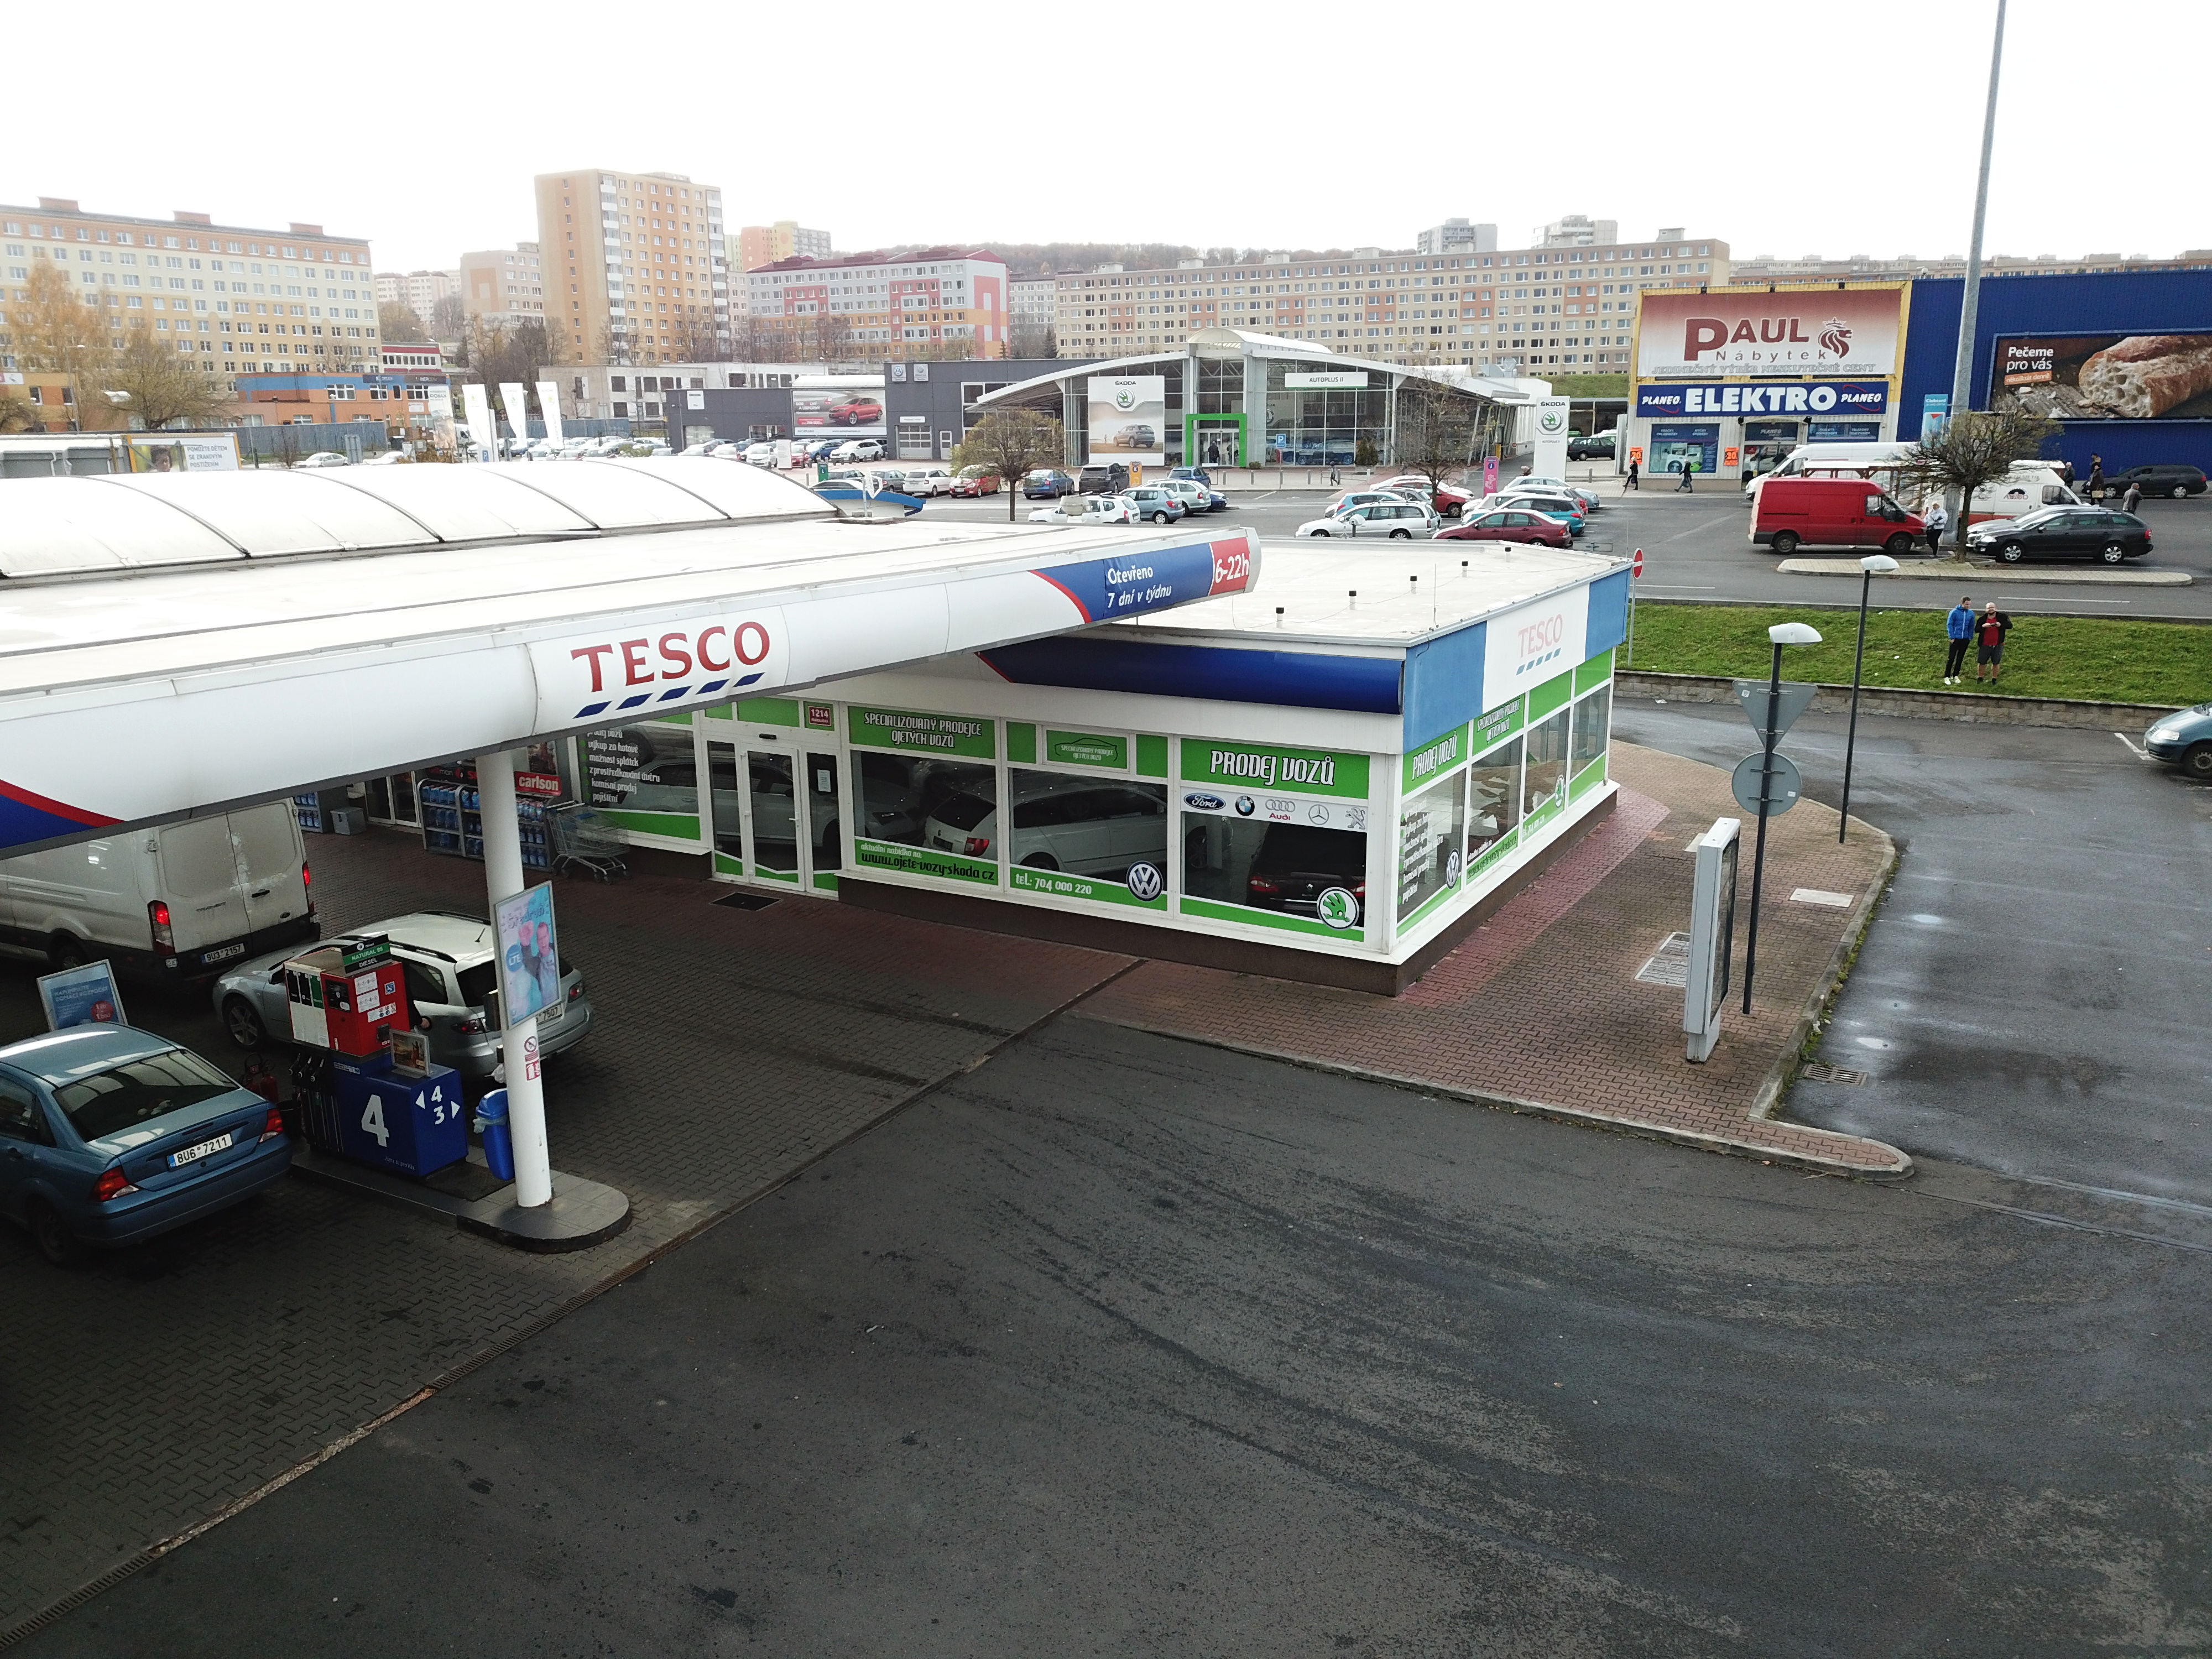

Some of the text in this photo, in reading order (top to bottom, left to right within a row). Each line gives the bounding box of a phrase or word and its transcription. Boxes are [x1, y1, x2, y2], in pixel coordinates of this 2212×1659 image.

[1684, 317, 1809, 361] PAUL
[1716, 350, 1827, 363] Nábytek
[2008, 346, 2054, 357] Pečeme
[1652, 364, 1717, 375] JEDINEČNÝ
[1761, 362, 1840, 374] NESKUTEČNÉ
[1843, 363, 1876, 373] CENY
[2006, 357, 2052, 373] pro vás
[1642, 387, 1881, 413] PLANEO ELEKTRO PLANEO
[1108, 565, 1154, 585] Otevřeno
[1215, 553, 1249, 583] 6-22h
[1108, 585, 1172, 608] 7 dní v týdnu
[1518, 614, 1563, 658] TESCO
[571, 621, 770, 692] TESCO
[811, 709, 828, 718] 1214
[864, 712, 982, 737] SPECIALIZOVANÝ PRODEJCE
[588, 740, 607, 752] výkup
[618, 743, 638, 753] hotové
[891, 731, 955, 748] OJETÝCH VOZŮ
[589, 754, 639, 767] možnost splátek
[1412, 730, 1457, 780] PRODEJ VOZŮ
[589, 767, 660, 782] zprostředkování úvěru
[1210, 749, 1335, 786] PRODEJ VOZŮ
[519, 776, 559, 791] carlson
[592, 778, 637, 795] komisní prodej
[593, 792, 618, 803] pojištění
[1192, 795, 1217, 808] Ford
[861, 843, 886, 853] aktuální
[886, 846, 912, 857] nabídka
[1035, 878, 1053, 891] 704
[1055, 881, 1073, 892] 000
[1075, 884, 1092, 895] 220
[207, 945, 241, 961] 9U3 2157
[352, 949, 376, 961] NATURAL
[509, 955, 521, 966] LTE
[359, 958, 378, 968] DIESEL
[542, 1007, 558, 1020] 7507
[431, 1086, 442, 1102] 4
[361, 1094, 389, 1147] 4
[434, 1107, 445, 1125] 3
[177, 1137, 227, 1163] 8U6 7211
